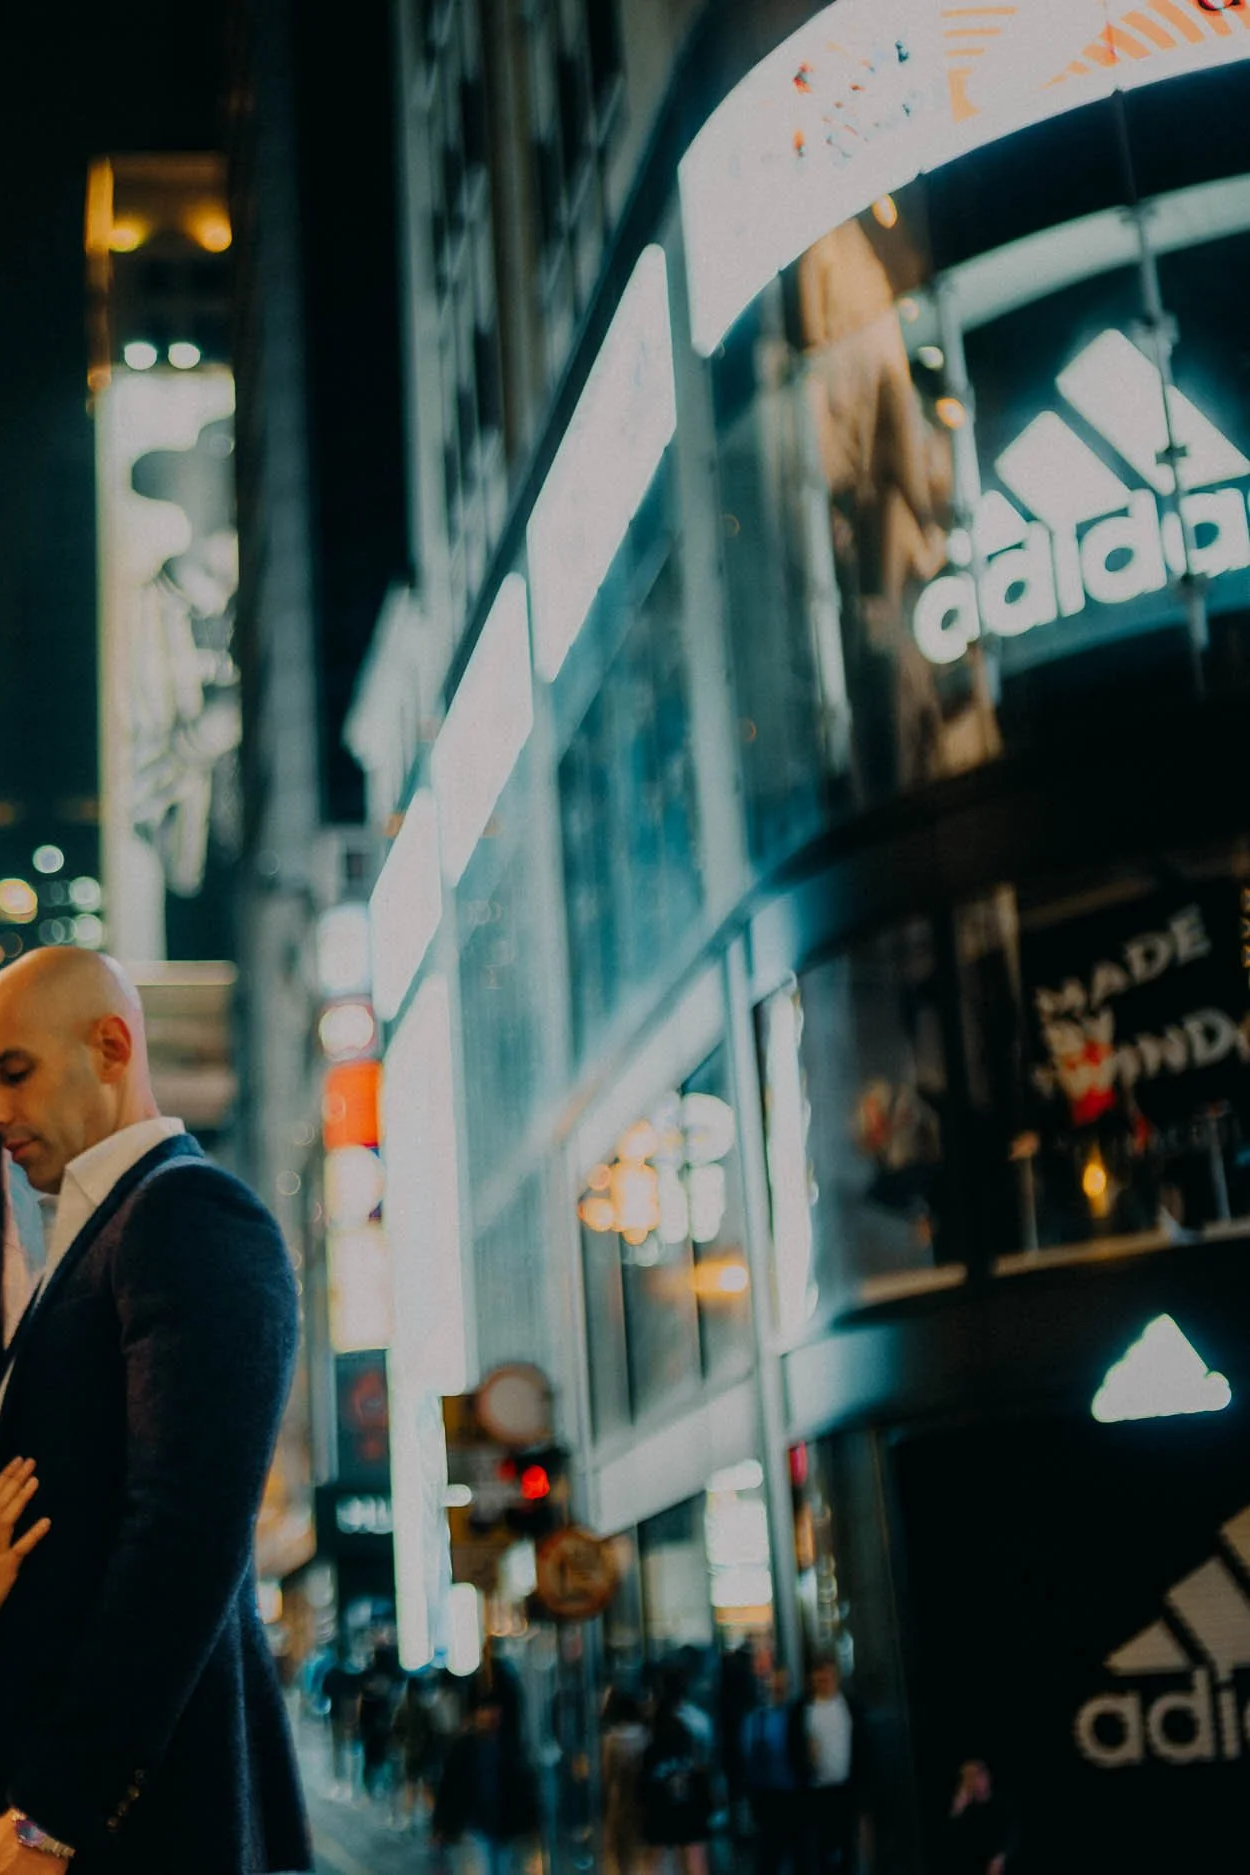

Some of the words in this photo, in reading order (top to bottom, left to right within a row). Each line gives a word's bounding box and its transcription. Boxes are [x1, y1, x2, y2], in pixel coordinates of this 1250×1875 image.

[913, 488, 1250, 664] adida
[1035, 903, 1211, 1021] MADE
[1074, 1667, 1250, 1767] adi
